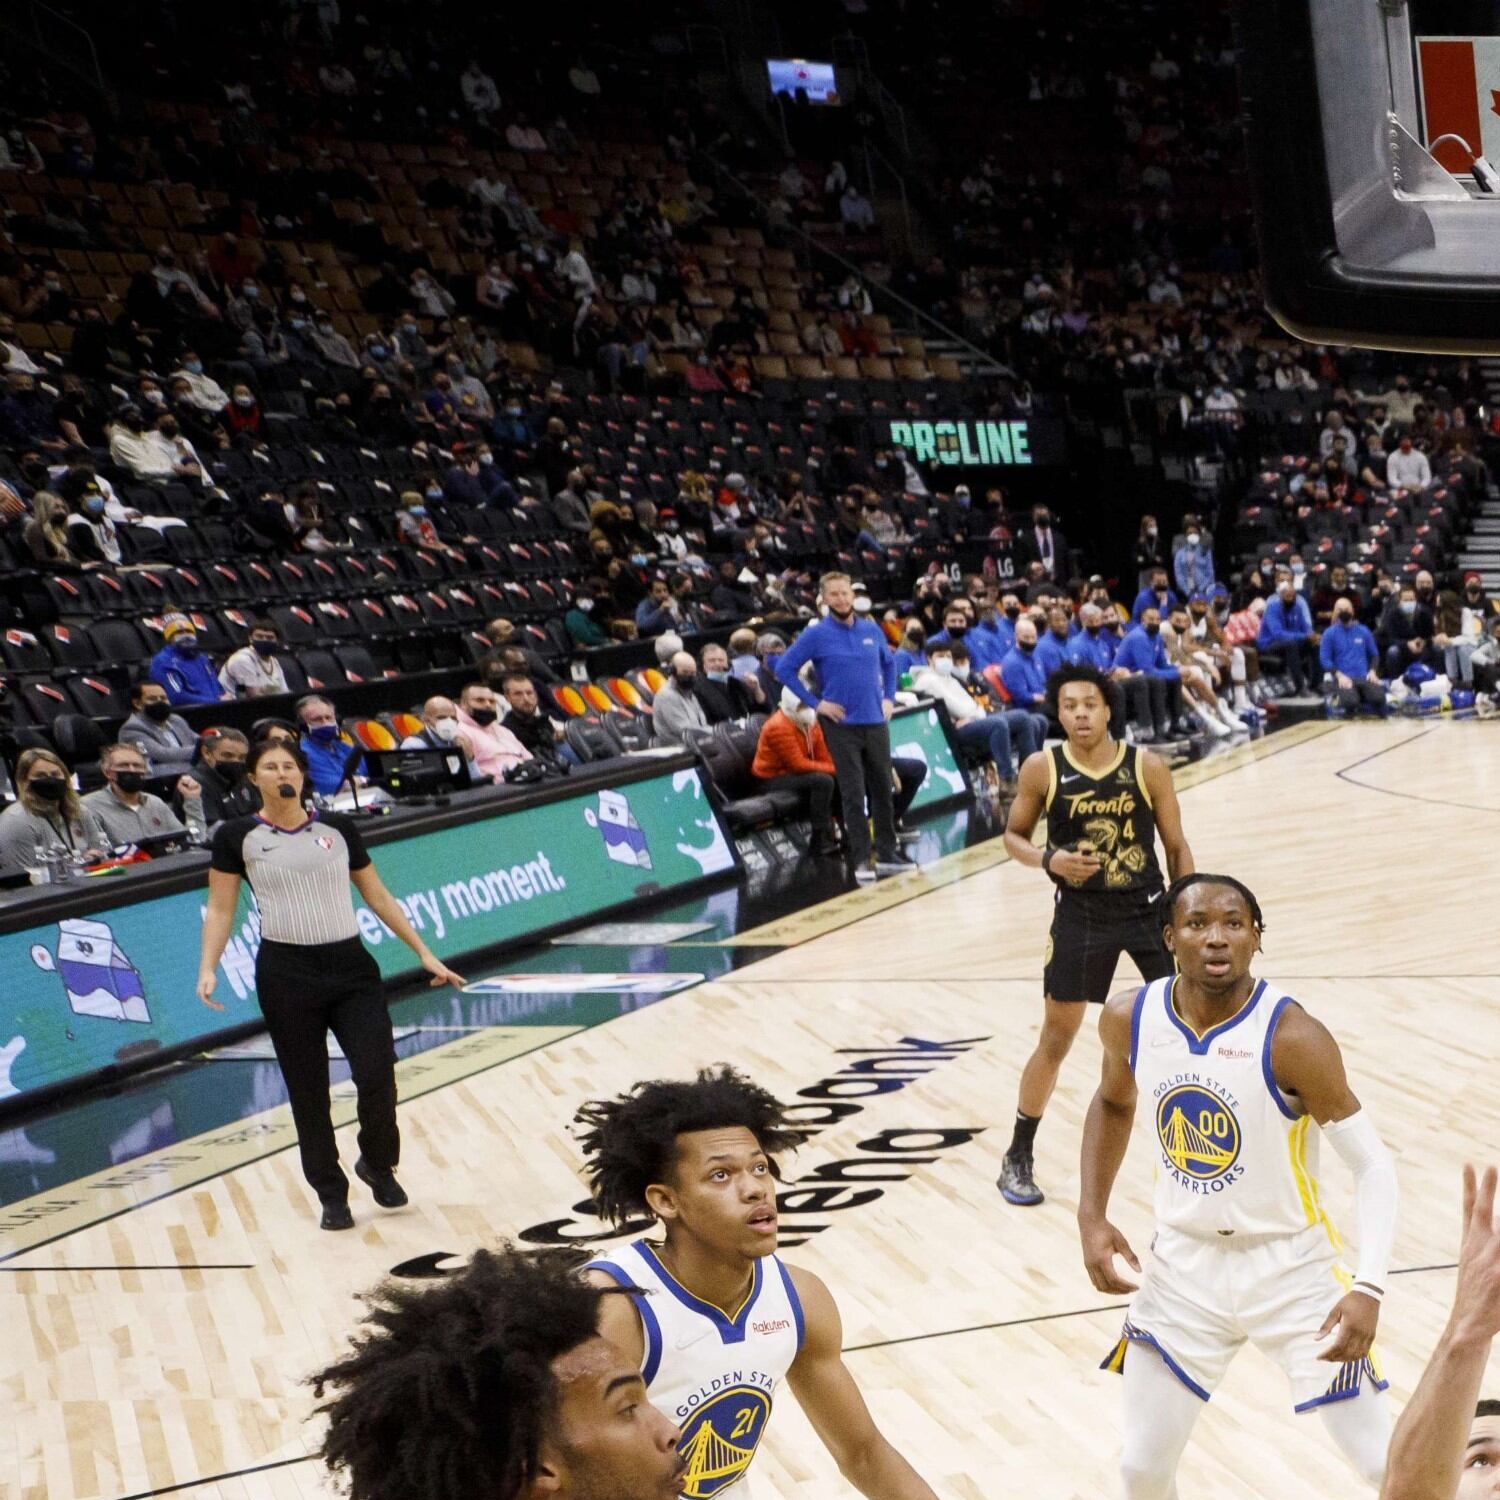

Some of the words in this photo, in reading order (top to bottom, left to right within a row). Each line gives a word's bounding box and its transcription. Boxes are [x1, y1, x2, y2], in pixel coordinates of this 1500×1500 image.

[890, 420, 1032, 464] PROLINE
[1061, 789, 1136, 819] Toronto
[1122, 818, 1135, 840] 4
[356, 889, 446, 946] ery
[441, 851, 567, 920] moment.
[1217, 1046, 1254, 1059] Rakuten
[1153, 1072, 1200, 1099] GOLDEN
[1206, 1077, 1240, 1111] STATE
[1199, 1109, 1229, 1139] 00
[1161, 1152, 1246, 1196] WARRIORS
[752, 1319, 791, 1334] Rakuten
[676, 1370, 744, 1419] GOLDEN
[750, 1370, 776, 1392] STA
[730, 1404, 761, 1440] 21
